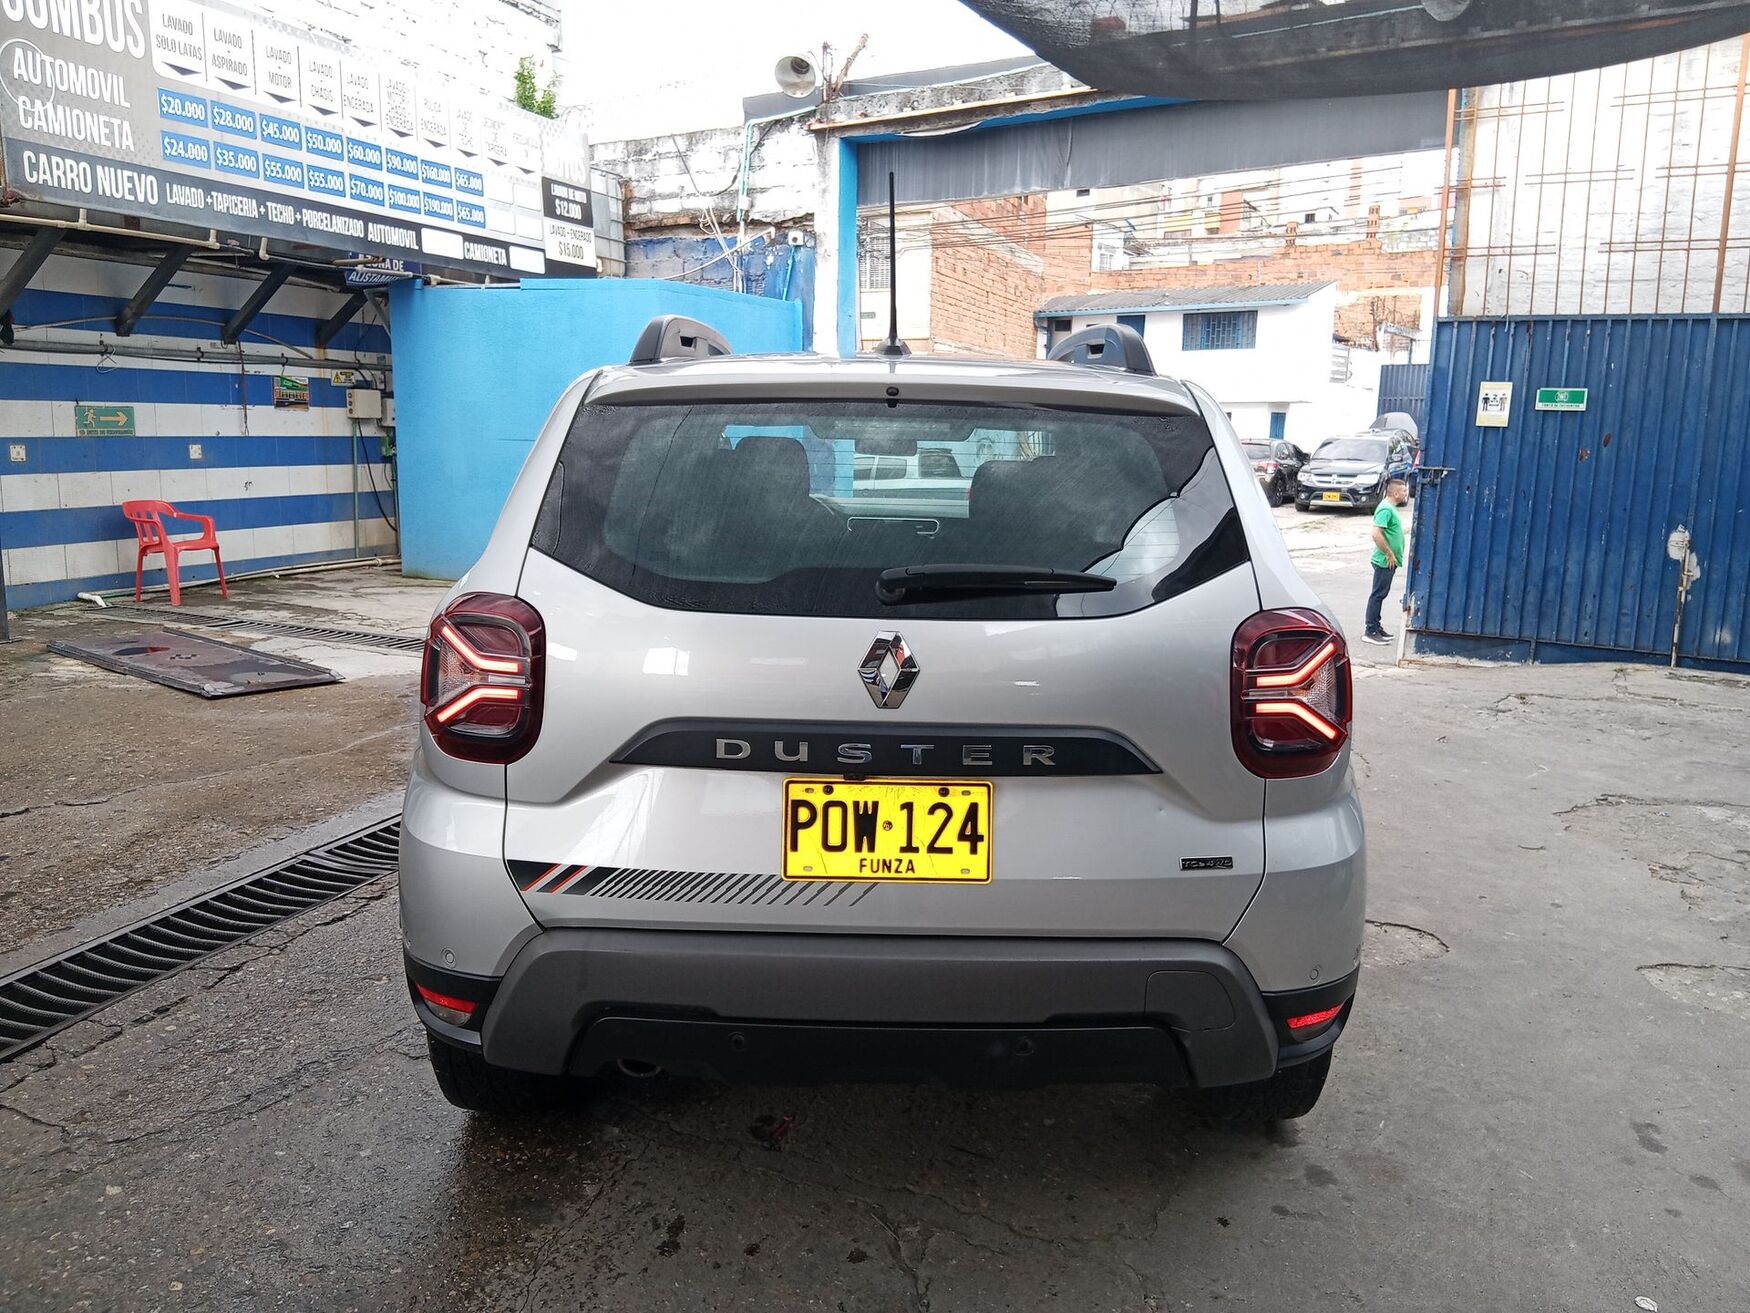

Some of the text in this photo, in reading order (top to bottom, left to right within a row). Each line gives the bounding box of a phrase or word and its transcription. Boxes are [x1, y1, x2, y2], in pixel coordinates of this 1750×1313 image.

[162, 13, 194, 36] LAVADO
[156, 34, 203, 61] SOLO LATAS
[213, 27, 243, 49] LAVADO
[211, 53, 248, 77] ASPIRADO
[265, 45, 292, 65] LAVADO
[13, 47, 131, 108] AUTOMOVIL
[268, 71, 292, 89] MOTOR
[18, 95, 135, 151] CAMIONETA
[161, 94, 205, 120] $20.000
[213, 106, 254, 133] $28.000
[262, 119, 300, 143] $45.000
[307, 131, 342, 154] $50.000
[348, 142, 381, 165] $60.000
[387, 152, 417, 174] $90.000
[163, 136, 208, 162] $24.000
[215, 147, 257, 172] $35.000
[264, 159, 302, 182] $55.000
[309, 169, 344, 192] $55.000
[351, 178, 384, 201] $70.000
[23, 150, 92, 194] CARRO
[97, 165, 158, 205] NUEVO
[166, 182, 205, 209] LAVADO
[266, 201, 294, 225] TECHO
[302, 208, 365, 238] PORCELANIZADO
[367, 222, 419, 250] AUTOMOVIL
[464, 241, 507, 266] CAMIONETA
[558, 240, 584, 259] $15.000
[394, 259, 404, 272] DE
[715, 738, 1056, 766] DUSTER
[790, 799, 985, 855] POW 124
[859, 858, 916, 875] FUNZA
